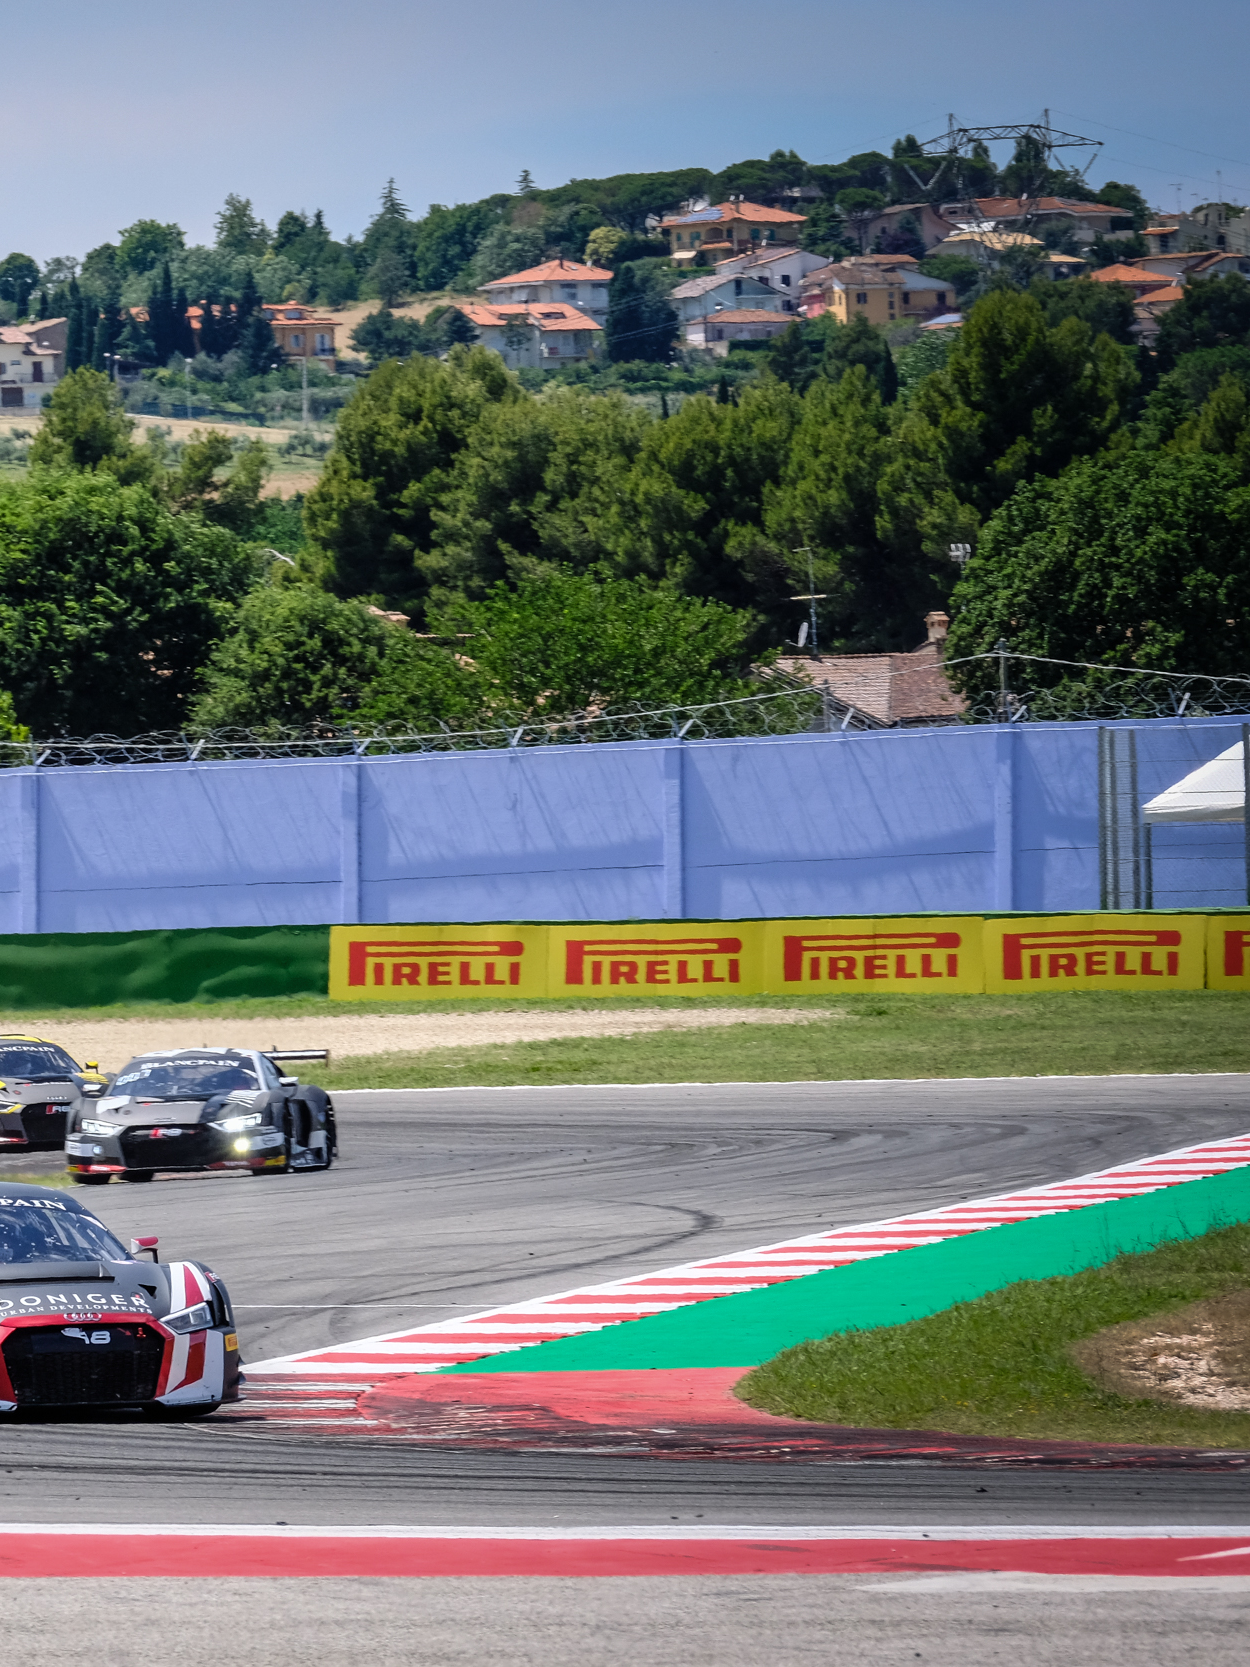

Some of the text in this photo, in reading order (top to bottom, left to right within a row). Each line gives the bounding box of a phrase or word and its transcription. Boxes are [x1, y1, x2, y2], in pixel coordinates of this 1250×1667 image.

[348, 941, 524, 986] PIRELLI
[565, 937, 743, 985] PIRELLI
[783, 932, 961, 981] PIRELLI
[1002, 930, 1182, 980] PIRELLI
[140, 1059, 241, 1070] BLANCPAIN
[0, 1304, 153, 1317] URBAN DEVELOPMENTS
